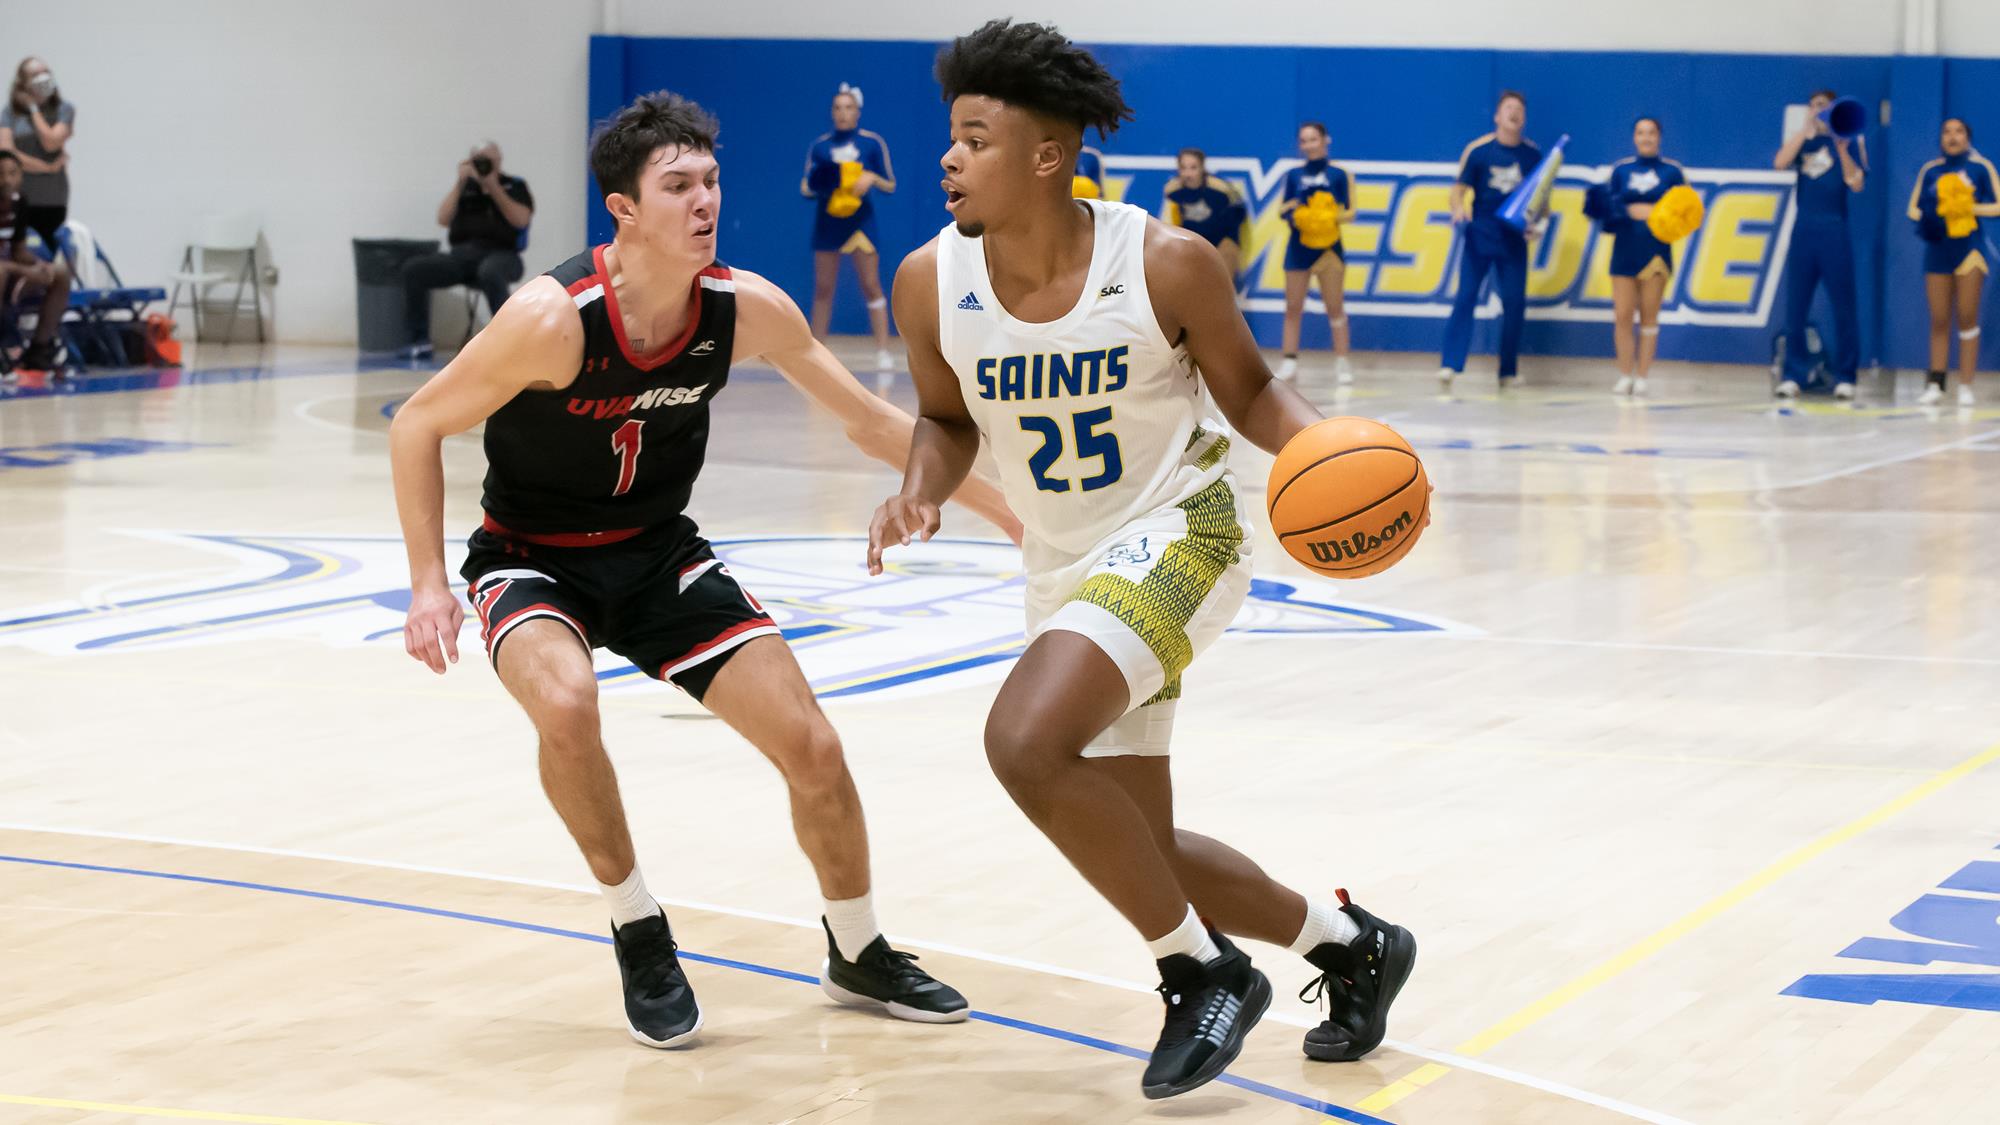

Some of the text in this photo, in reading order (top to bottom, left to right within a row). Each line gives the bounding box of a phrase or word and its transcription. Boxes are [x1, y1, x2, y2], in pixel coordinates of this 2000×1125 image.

[957, 301, 984, 311] adidas
[1100, 284, 1125, 298] SAC
[977, 344, 1129, 401] SAINTS
[611, 419, 647, 497] 1
[1018, 404, 1124, 494] 25
[1306, 510, 1414, 564] Wilson
